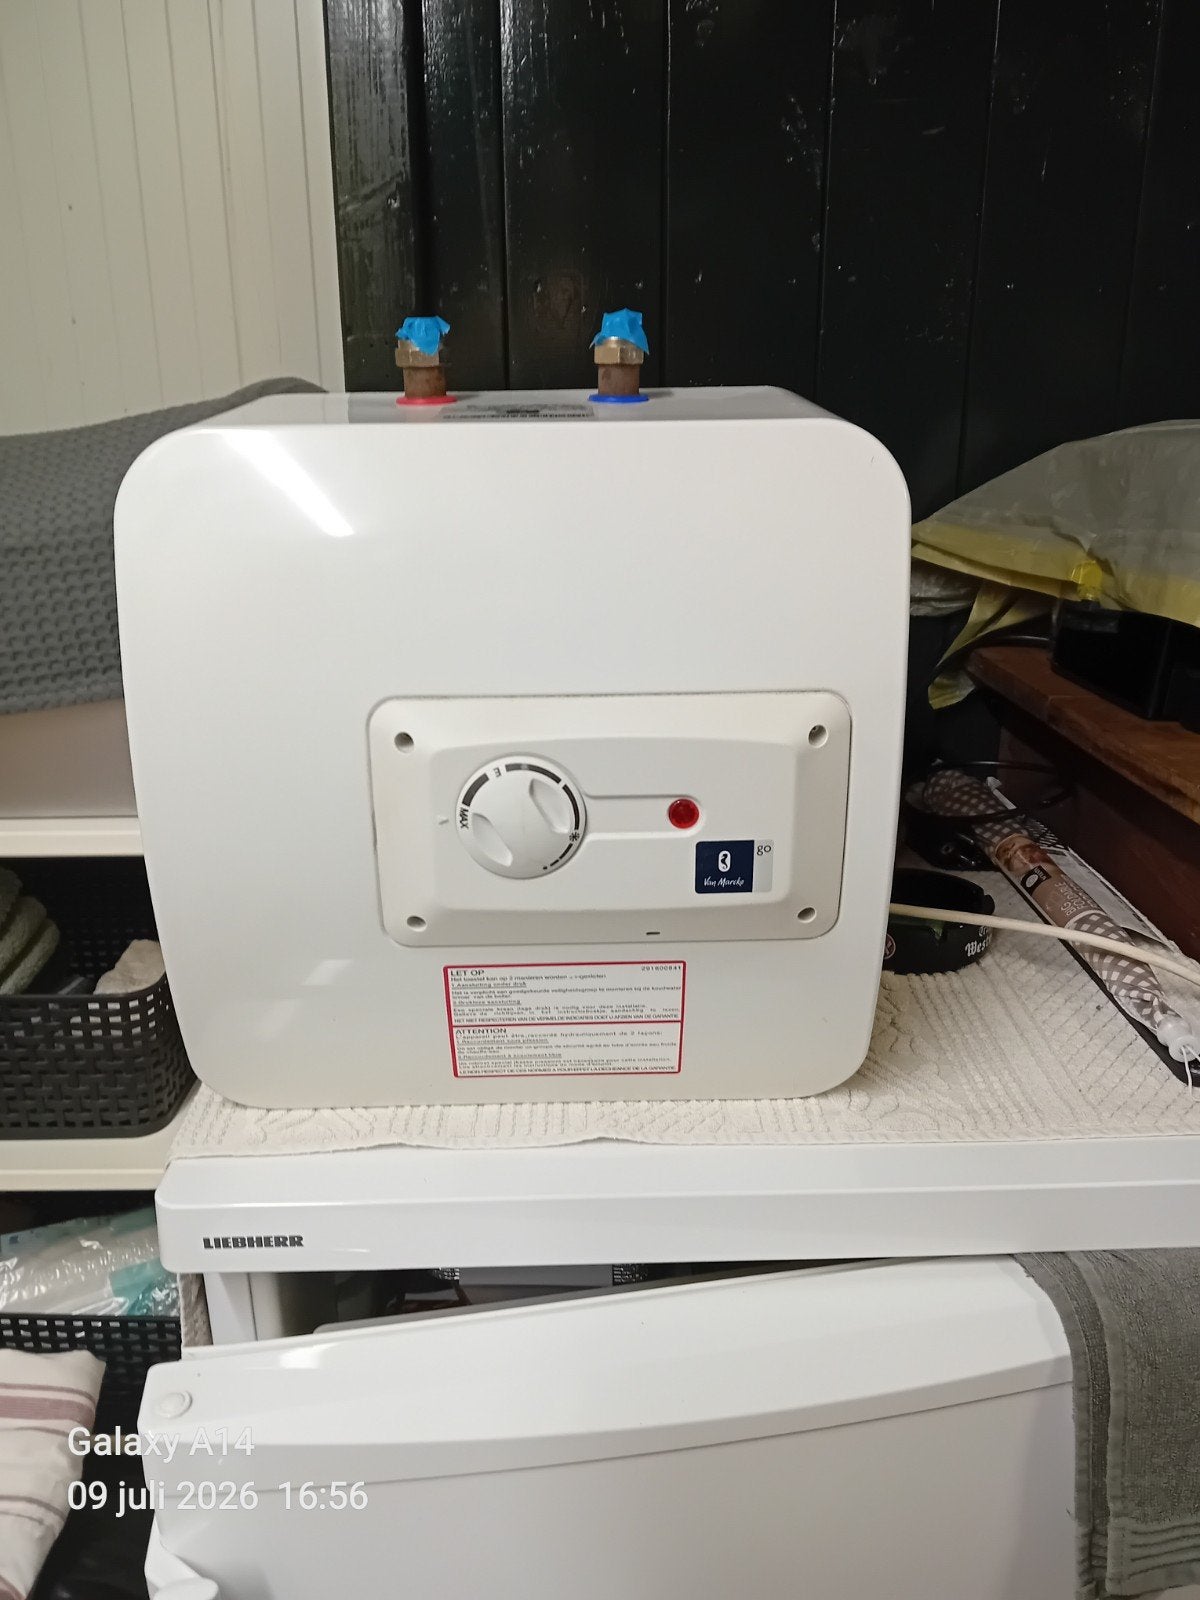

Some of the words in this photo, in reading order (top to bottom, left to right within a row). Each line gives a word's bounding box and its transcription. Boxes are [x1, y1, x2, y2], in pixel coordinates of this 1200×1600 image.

[460, 807, 469, 829] MAX
[756, 845, 772, 856] go
[703, 876, 717, 887] Van
[202, 1235, 304, 1249] LIEBHERR
